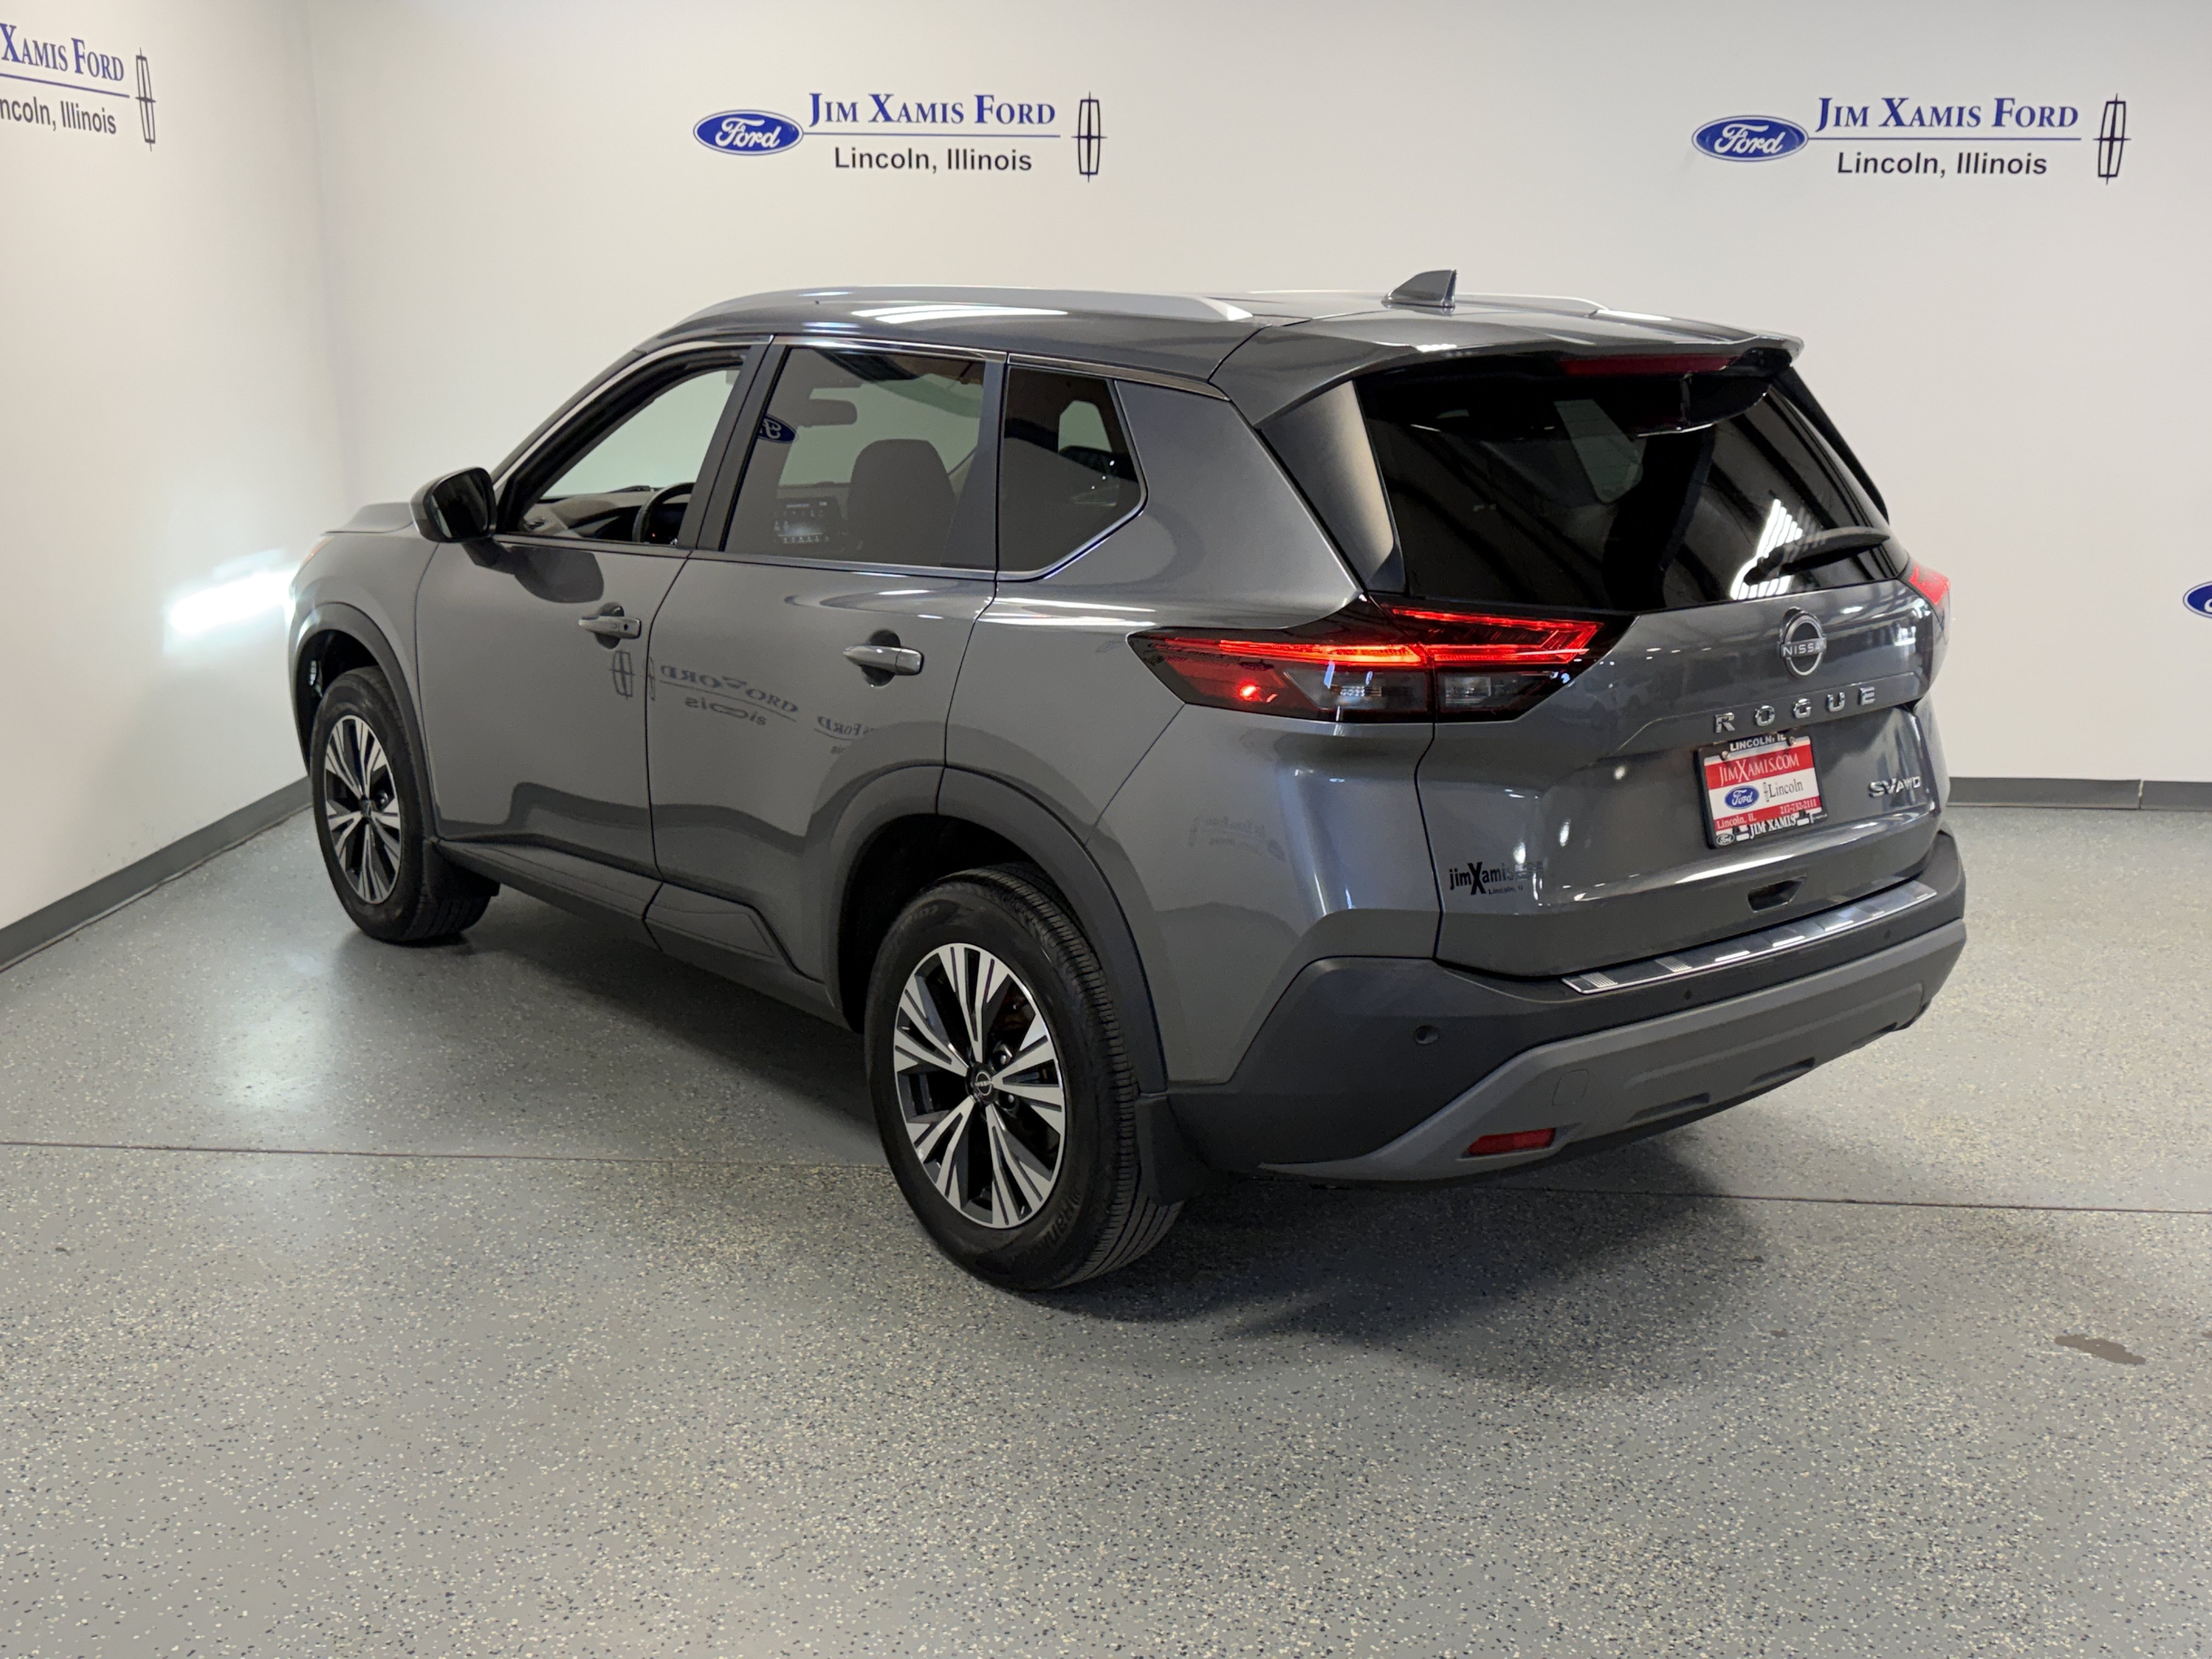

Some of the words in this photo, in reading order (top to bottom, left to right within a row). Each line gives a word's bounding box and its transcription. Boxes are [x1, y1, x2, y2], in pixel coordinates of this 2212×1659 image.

[71, 37, 125, 82] FORD
[60, 100, 117, 135] Illinois
[809, 93, 859, 127] JIM
[868, 94, 964, 124] XAMIS
[974, 94, 1056, 125] FORD
[1815, 97, 1870, 133] JIM
[1878, 97, 1981, 128] XAMIS
[1991, 97, 2079, 128] FORD
[715, 117, 782, 148] Ford
[1714, 123, 1786, 154] Ford
[835, 146, 937, 174] Lincoln,
[947, 148, 1032, 171] Illinois
[1837, 151, 1945, 178] Lincoln,
[1957, 152, 2047, 175] Illinois
[1714, 686, 1876, 733] ROGUE
[1731, 788, 1753, 806] Ford
[1768, 778, 1804, 798] Lincoln
[1869, 777, 1897, 798] SV
[1719, 834, 1733, 845] Ford
